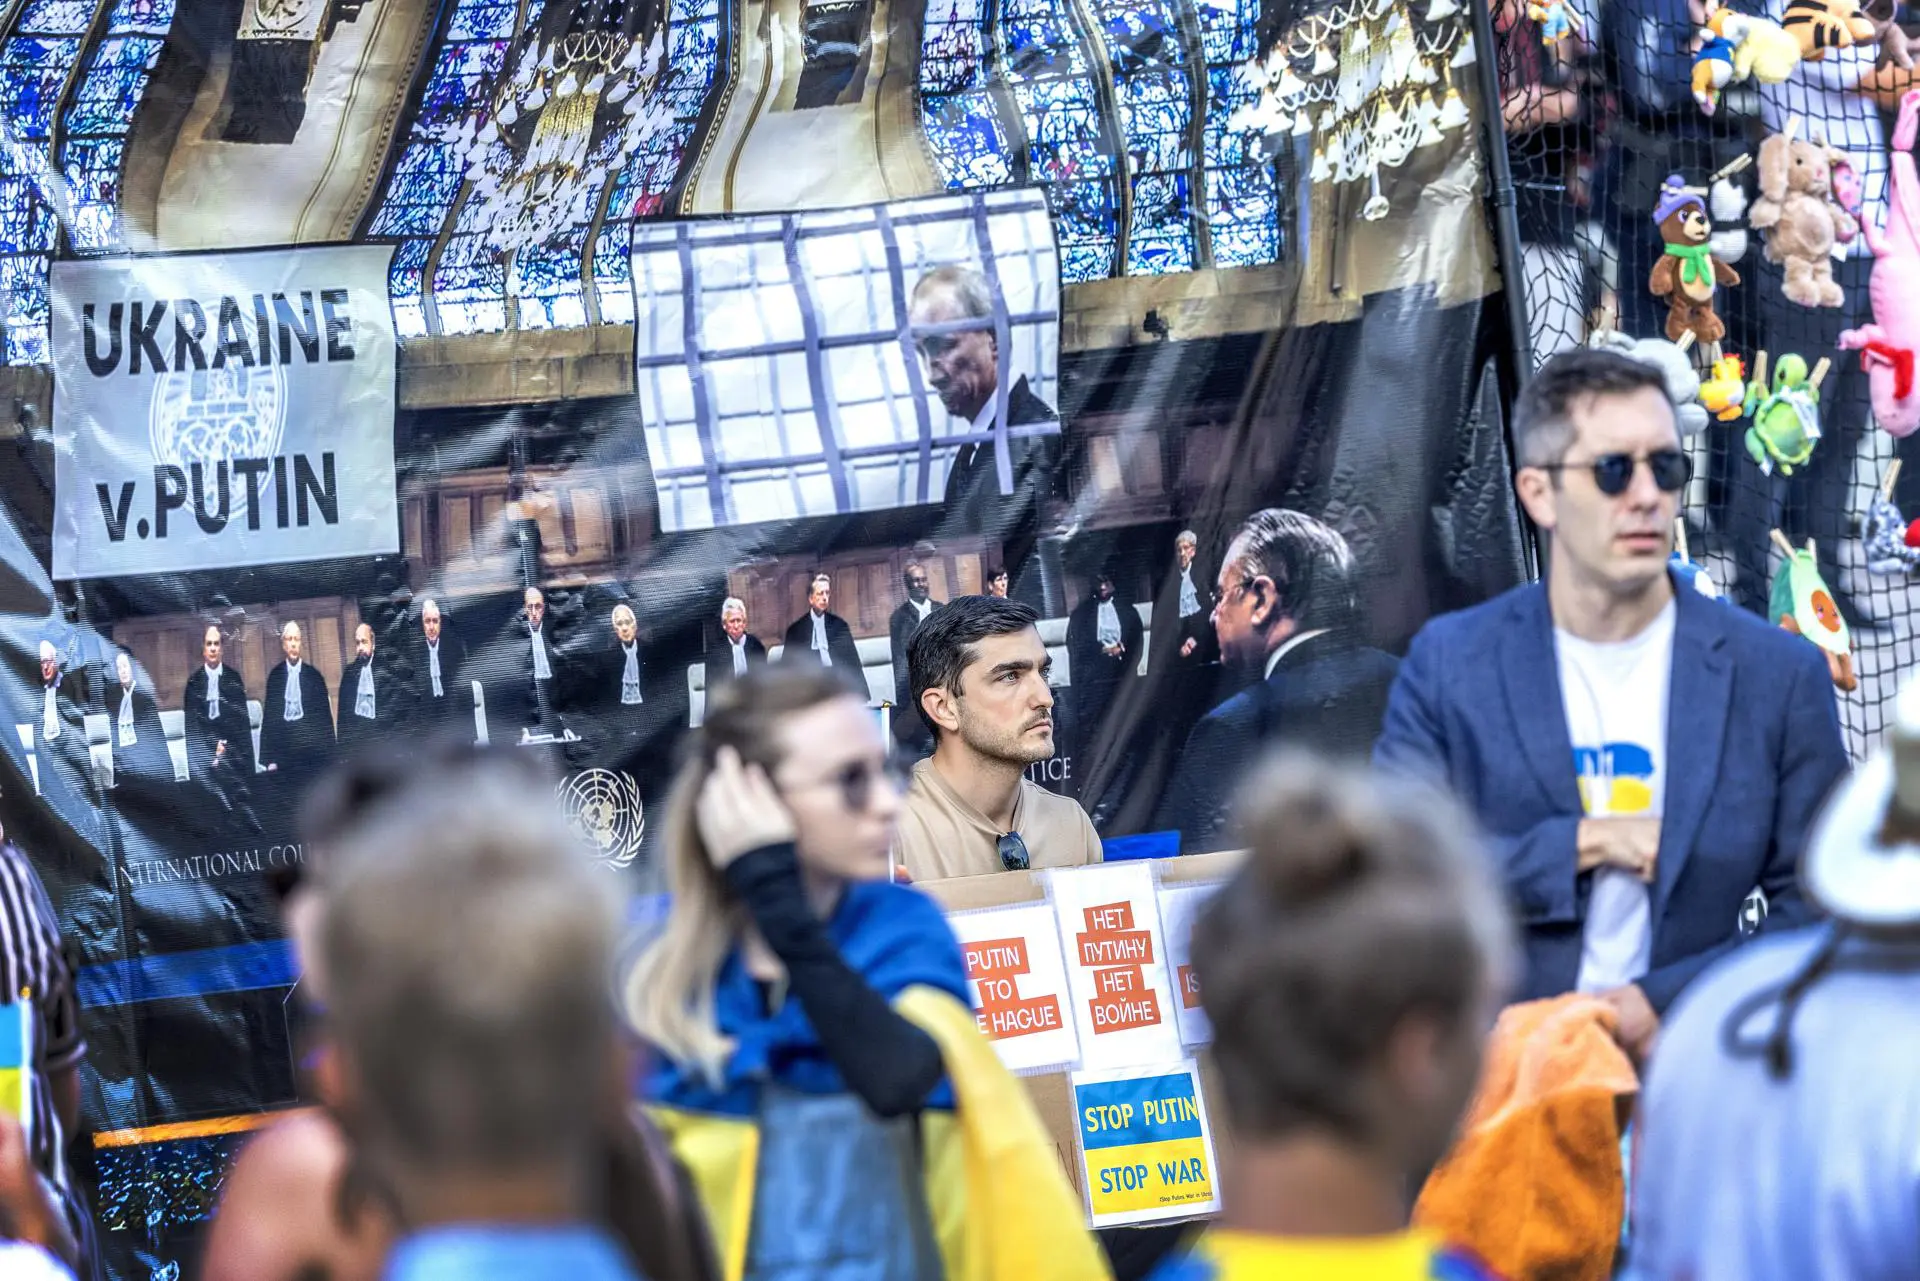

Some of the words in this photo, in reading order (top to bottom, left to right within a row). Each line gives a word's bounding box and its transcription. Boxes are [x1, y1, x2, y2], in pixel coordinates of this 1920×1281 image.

[83, 289, 355, 377] UKRAINE
[1093, 908, 1124, 931] НЕТ
[966, 945, 1021, 972] PUTIN
[1083, 937, 1147, 962] ПУТИНУ
[985, 978, 1012, 1001] TO
[1102, 970, 1134, 993] НЕТ
[992, 1005, 1057, 1033] HAGUE
[1094, 996, 1154, 1026] ВОЙНЕ
[1085, 1103, 1134, 1132] STOP
[1143, 1095, 1199, 1126] PUTIN
[1100, 1164, 1149, 1194] STOP
[1157, 1157, 1206, 1186] WAR
